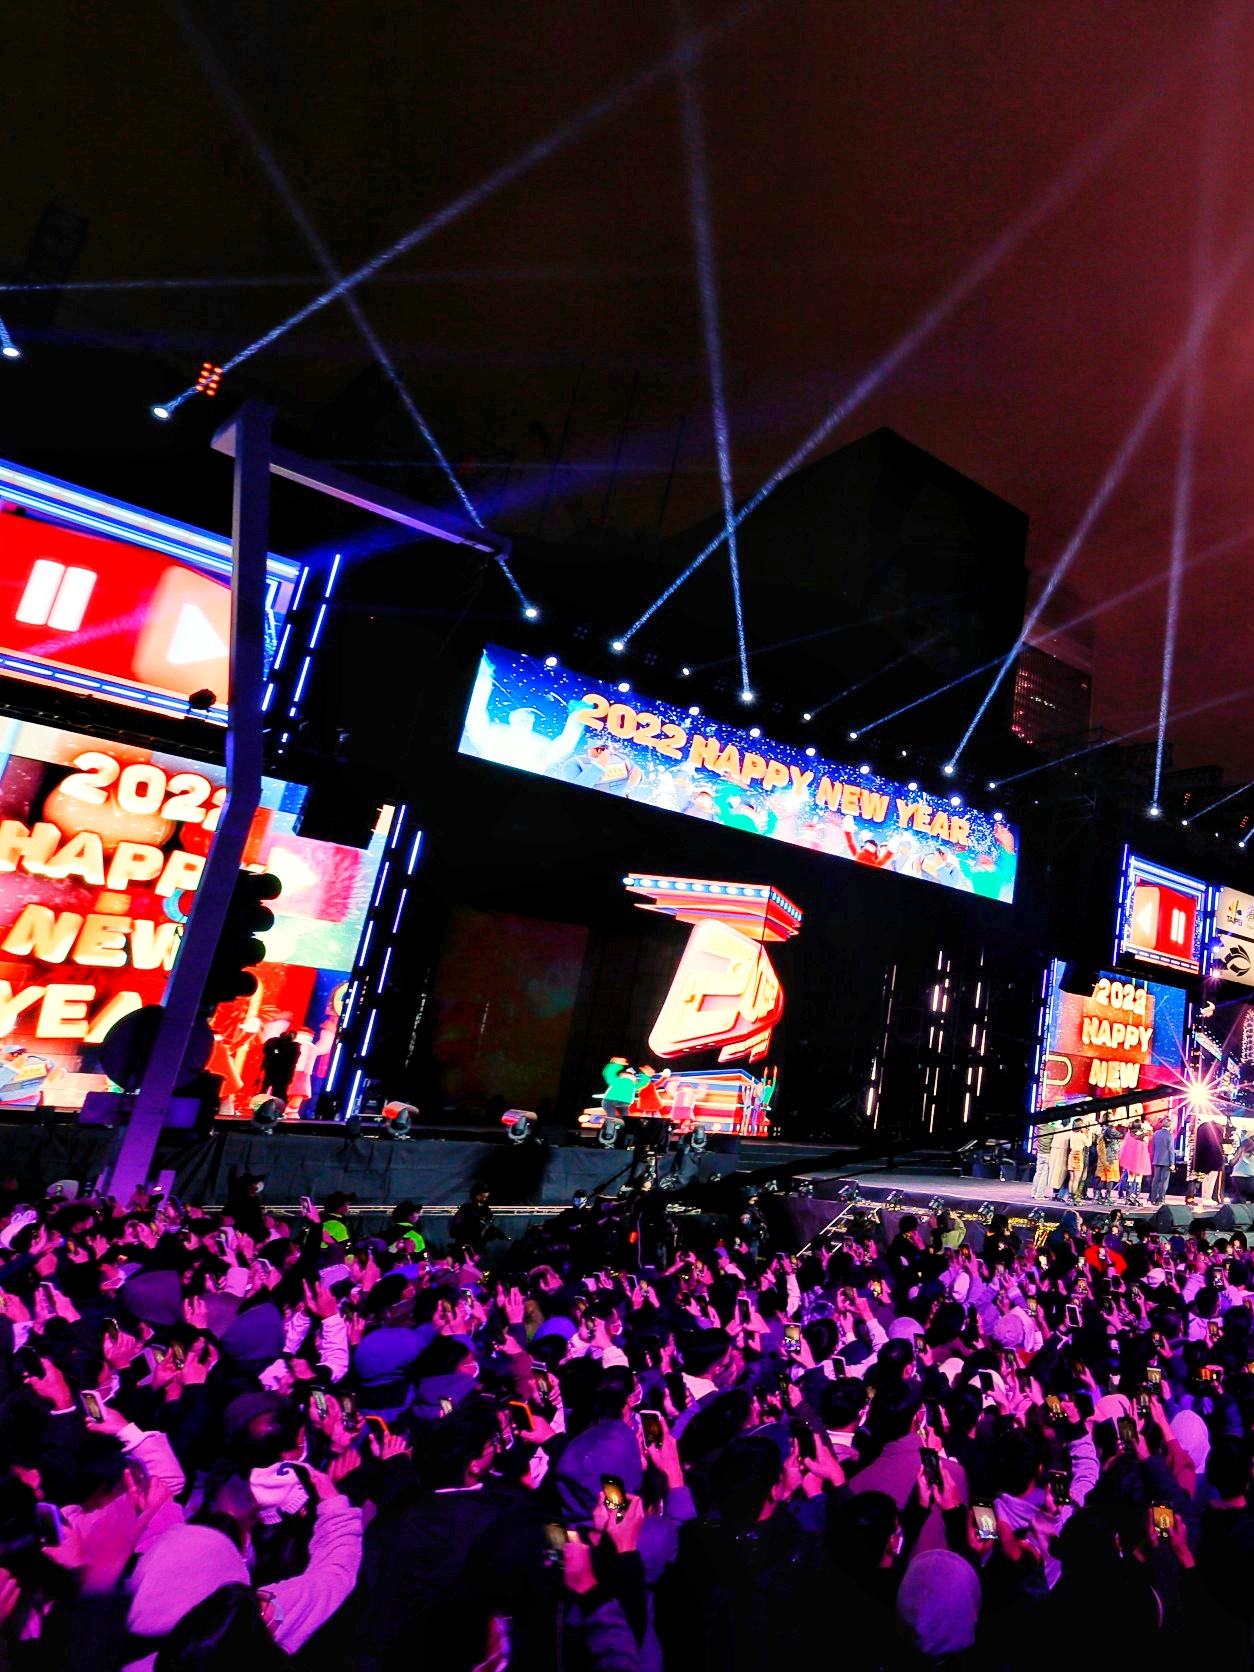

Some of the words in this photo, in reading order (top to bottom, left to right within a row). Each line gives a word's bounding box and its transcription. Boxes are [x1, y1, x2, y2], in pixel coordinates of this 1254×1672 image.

[576, 693, 688, 760] 2022
[687, 733, 815, 799] HAPPY
[815, 776, 890, 823] NEW
[896, 798, 971, 847] YEAR
[0, 820, 207, 898] HAPP
[1088, 1058, 1140, 1089] NEW
